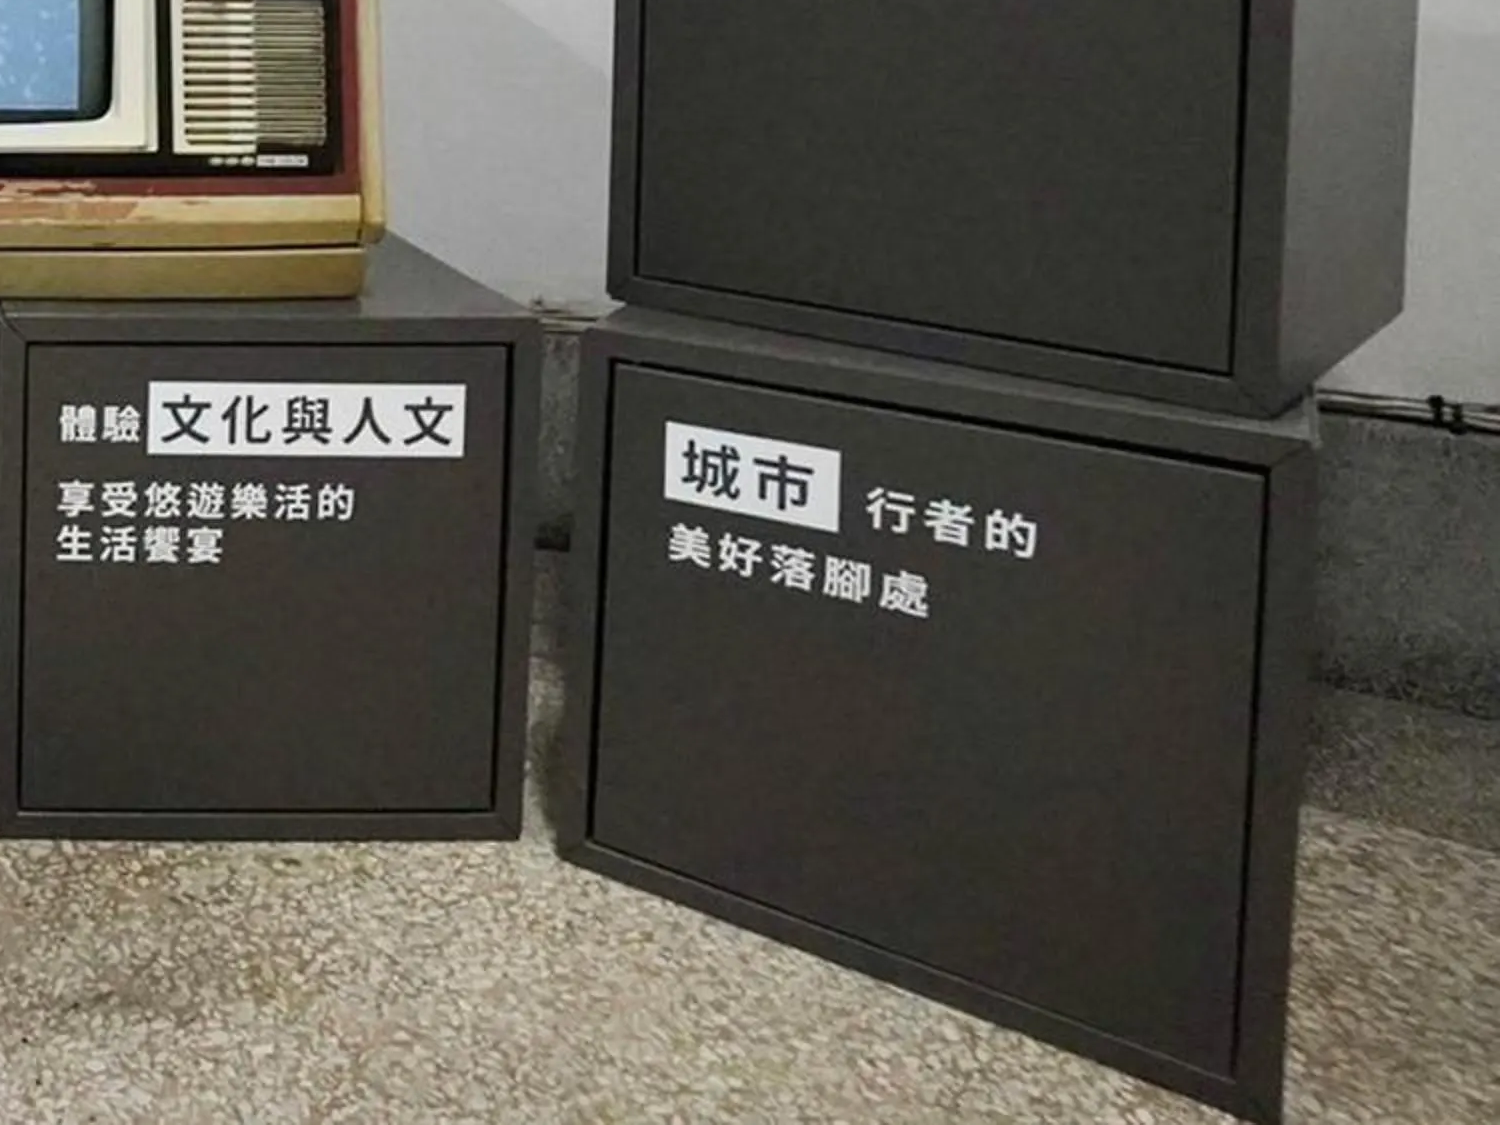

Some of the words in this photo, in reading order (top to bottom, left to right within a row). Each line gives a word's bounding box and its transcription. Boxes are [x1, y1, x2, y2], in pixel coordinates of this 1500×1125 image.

[57, 479, 354, 521] 享受悠遊樂活的
[56, 524, 223, 564] 生活饗宴
[668, 522, 929, 618] 美好落腳處
